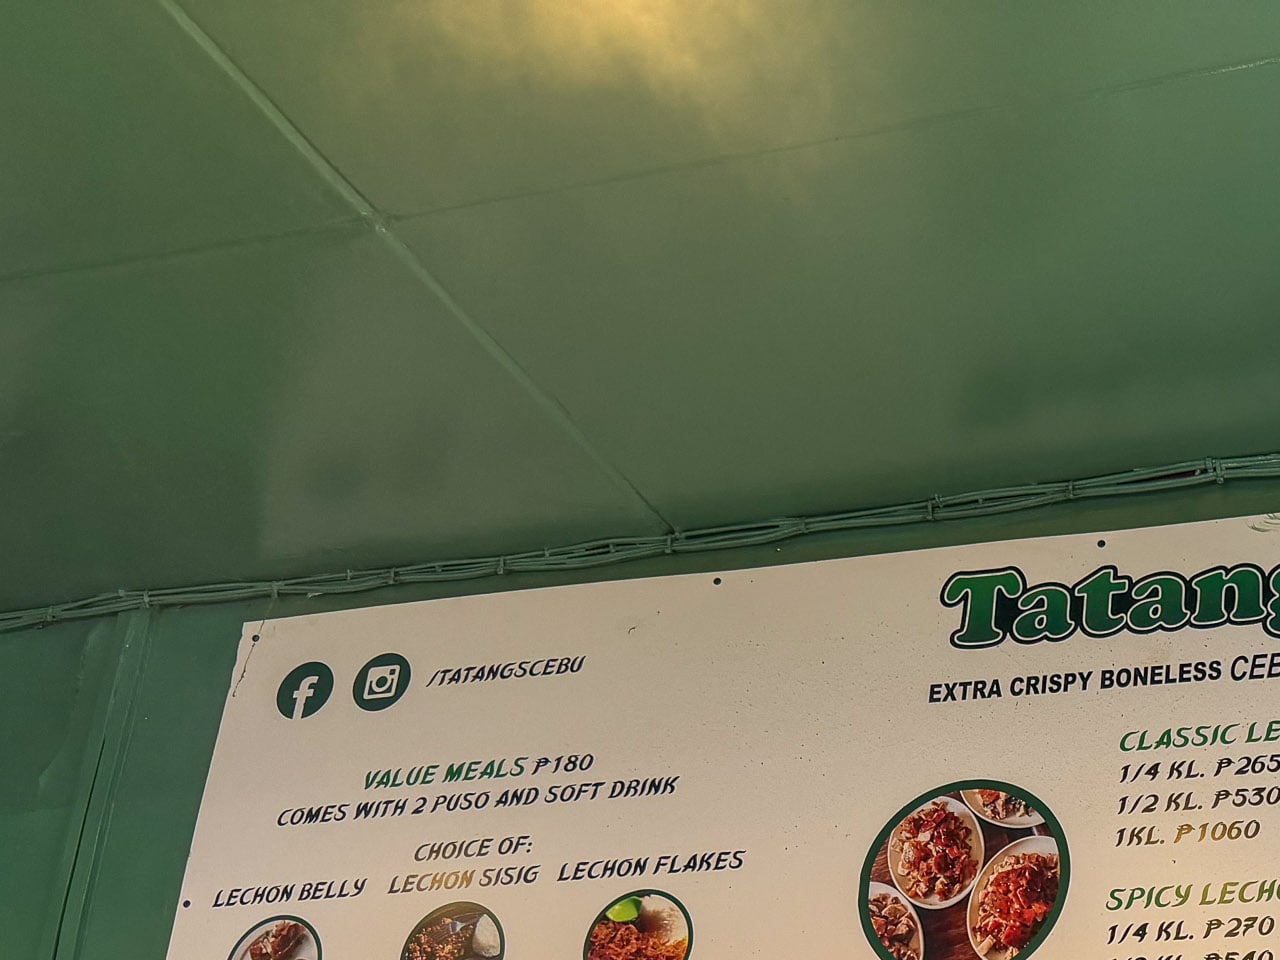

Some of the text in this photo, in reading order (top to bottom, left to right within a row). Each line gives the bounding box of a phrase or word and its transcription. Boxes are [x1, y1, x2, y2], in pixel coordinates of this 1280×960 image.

[425, 655, 587, 688] /TATANGSCEBU
[928, 678, 1002, 704] EXTRA
[1009, 670, 1094, 697] CRISPY
[1100, 660, 1222, 690] BONELESS
[1119, 722, 1241, 752] CLASSIC
[364, 764, 440, 790] VALUE
[441, 756, 529, 783] MEALS
[1119, 762, 1162, 784] 1/4
[1166, 759, 1205, 781] KL.
[277, 775, 680, 827] COMES WITH 2 PUSO AND SOFT DRINK
[1117, 794, 1159, 815] 1/2
[1164, 791, 1203, 813] KL.
[414, 835, 533, 862] CHOICE OF:
[1115, 825, 1165, 848] 1KL.
[387, 864, 541, 895] LECHON SISIG
[556, 850, 747, 882] LECHON FLAKES
[211, 878, 368, 908] LECHON BELLY
[1105, 884, 1193, 911] SPICY
[1107, 922, 1150, 945] 1/4
[1155, 920, 1194, 942] KL.
